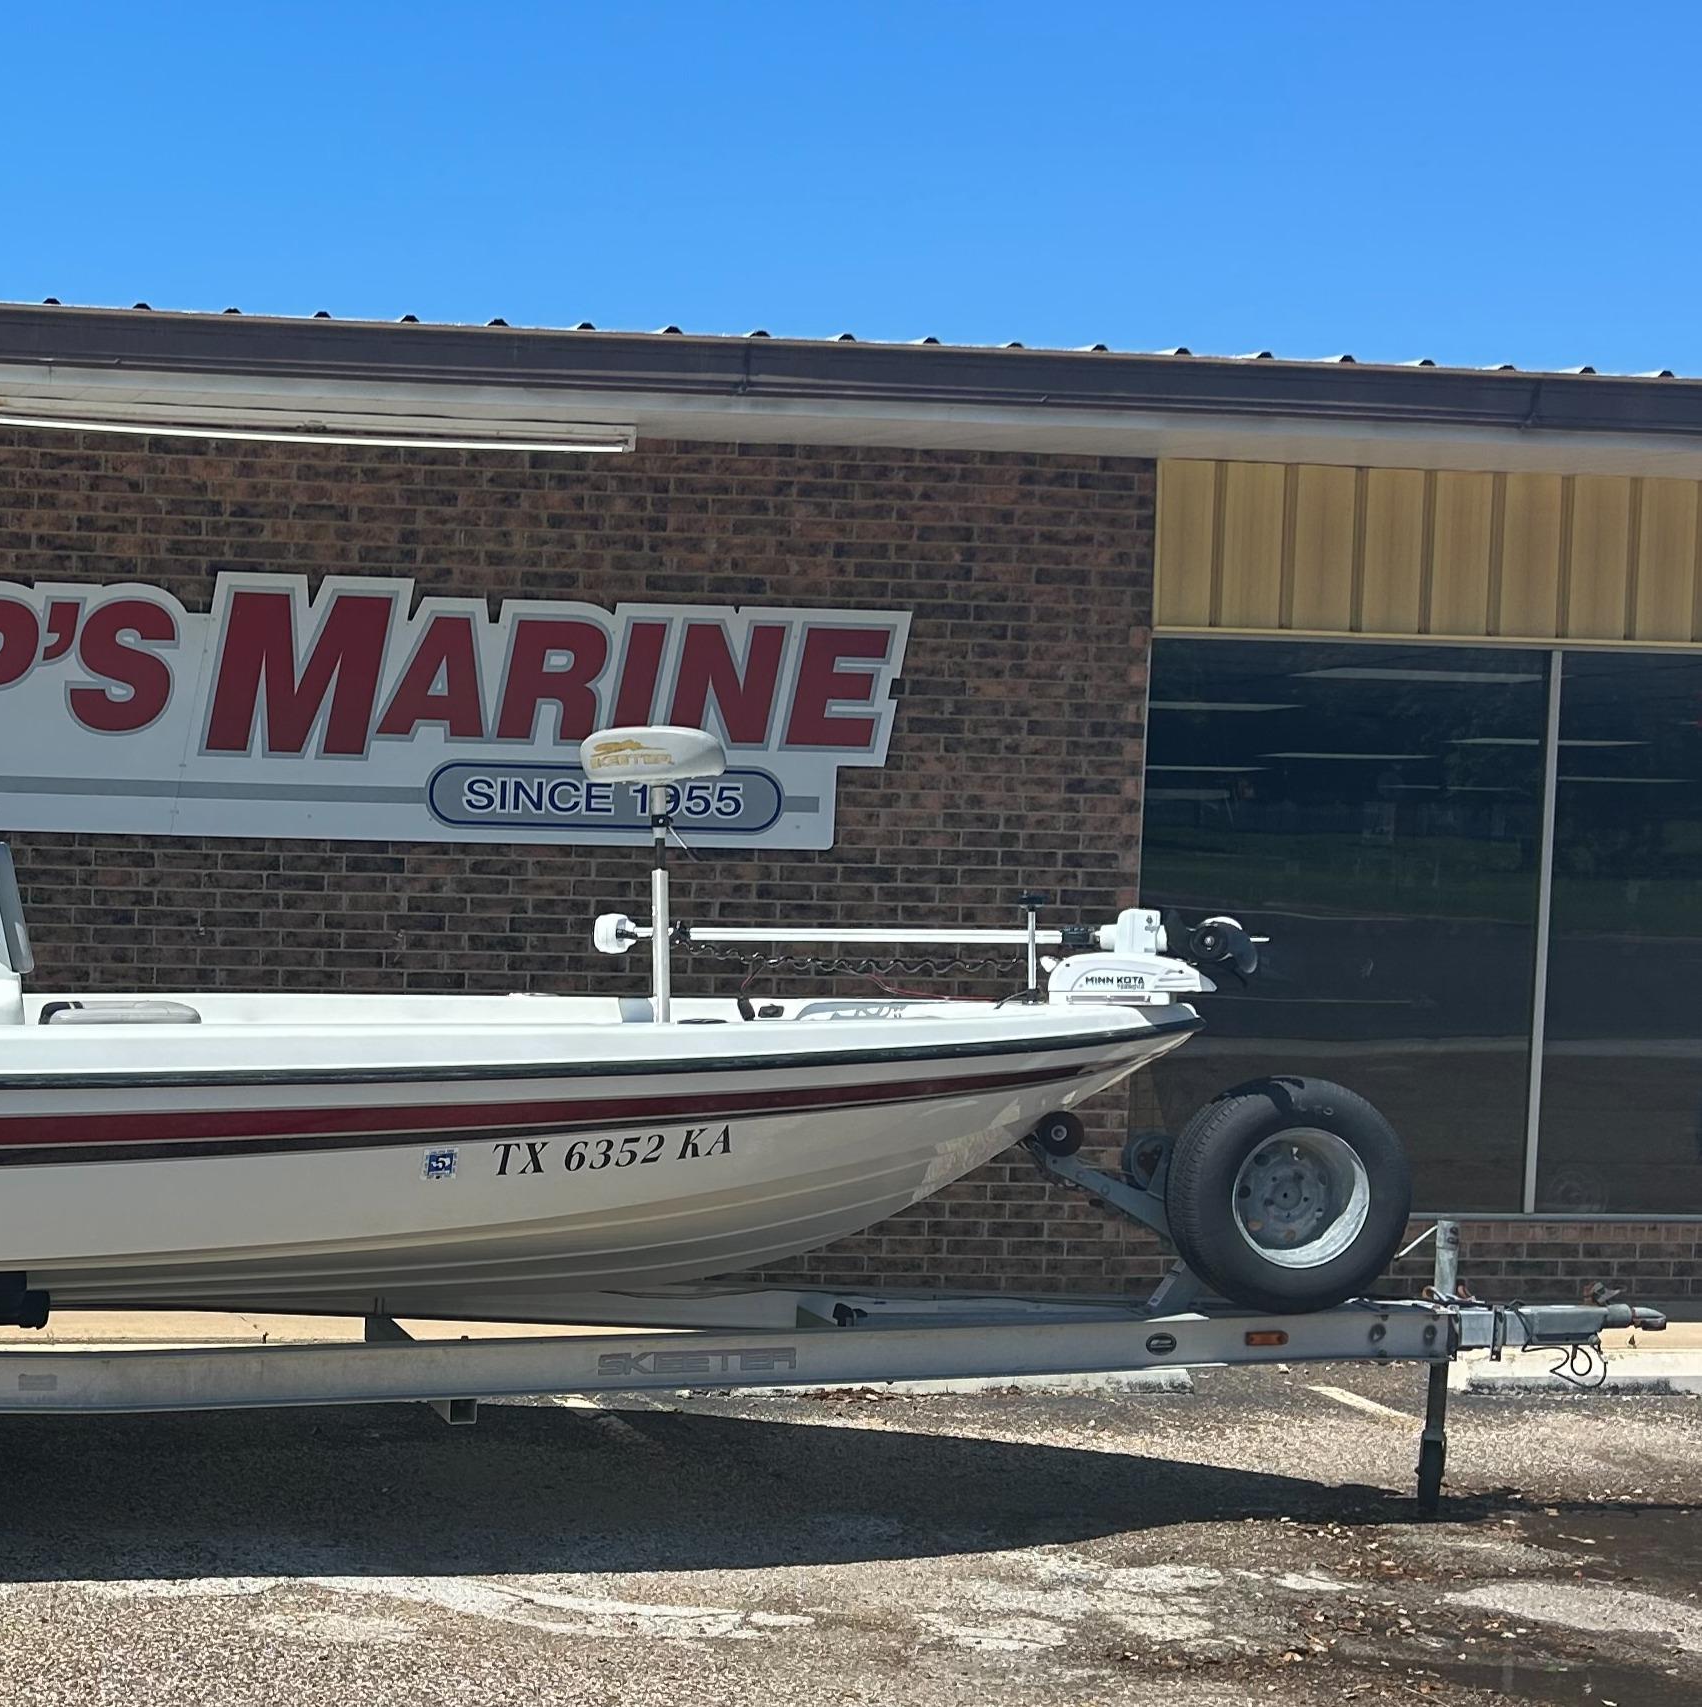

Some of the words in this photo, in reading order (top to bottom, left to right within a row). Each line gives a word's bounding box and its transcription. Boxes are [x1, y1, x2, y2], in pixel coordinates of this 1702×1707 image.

[204, 590, 892, 754] MARINE
[465, 779, 614, 815] SINCE
[1085, 976, 1114, 985] MINN
[1116, 976, 1145, 985] KOTA
[493, 1141, 550, 1176] TX
[564, 1133, 665, 1172] 6352
[677, 1123, 732, 1161] KA
[598, 1347, 797, 1375] SKEETER
